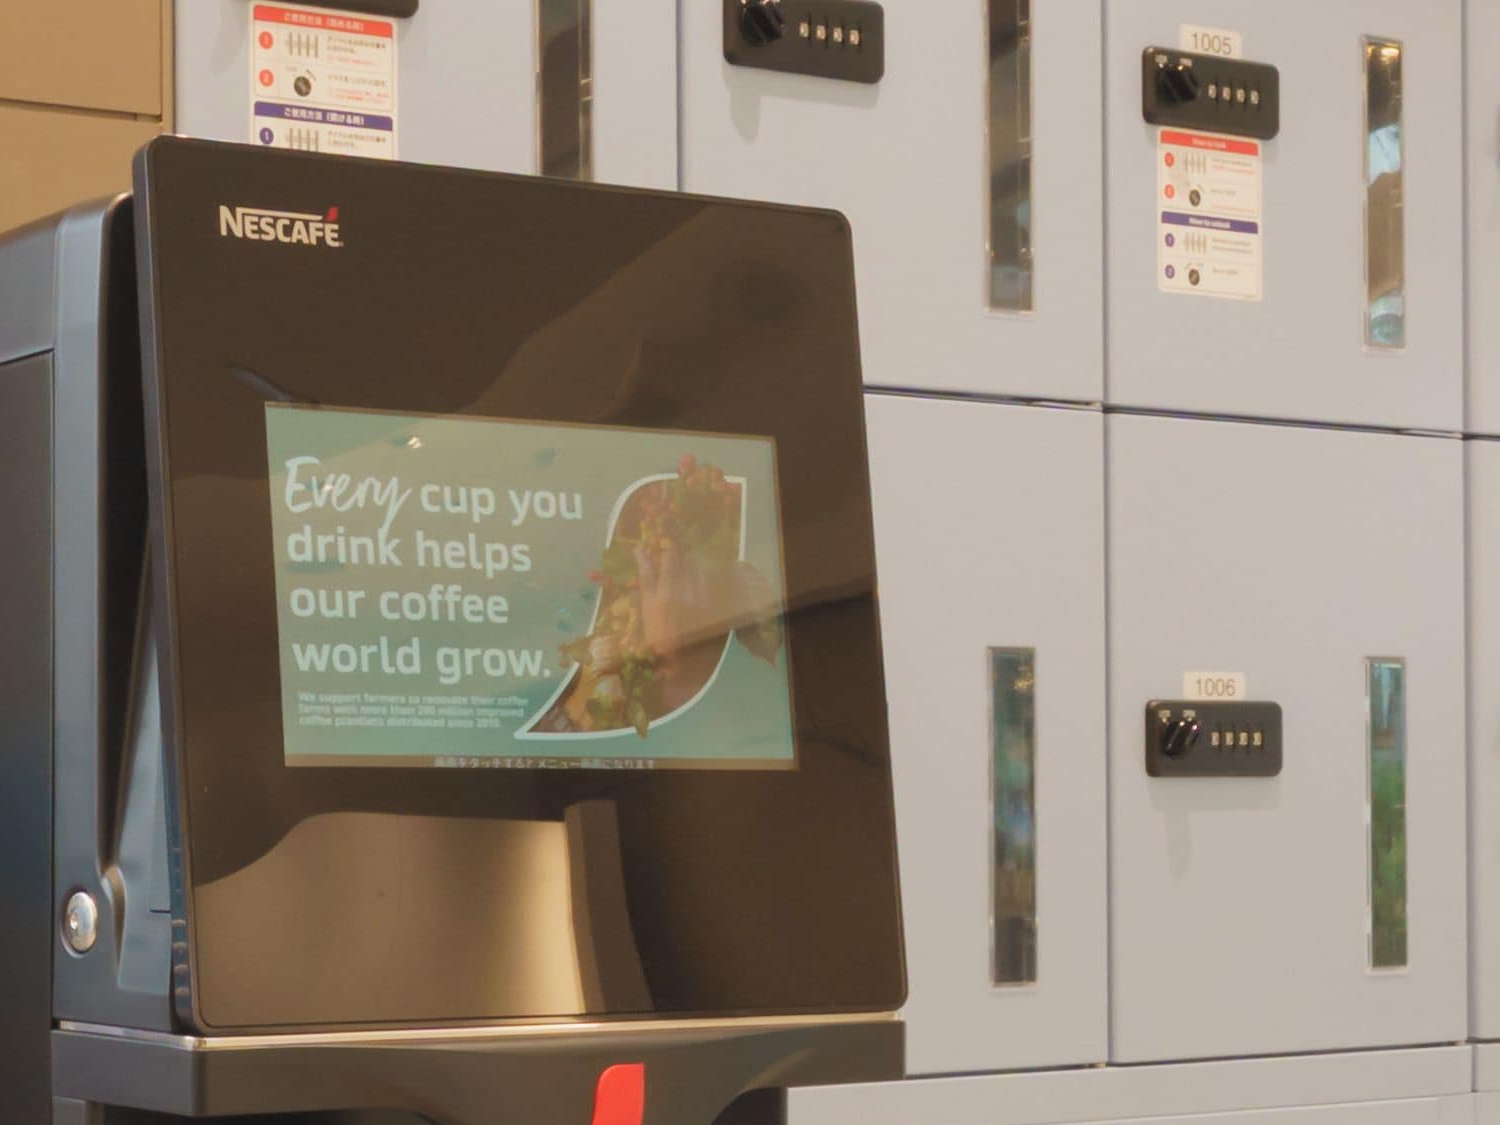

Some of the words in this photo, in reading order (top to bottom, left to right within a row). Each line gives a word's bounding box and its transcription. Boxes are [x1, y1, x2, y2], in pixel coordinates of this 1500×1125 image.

[1190, 32, 1233, 56] 1005
[284, 456, 412, 530] Every
[420, 482, 496, 522] cup
[507, 488, 583, 525] you
[286, 526, 402, 567] drink
[415, 530, 532, 578] helps
[290, 586, 365, 618] our
[379, 583, 510, 624] coffee
[292, 636, 422, 675] world
[436, 649, 552, 684] grow.
[1196, 678, 1236, 697] 1006
